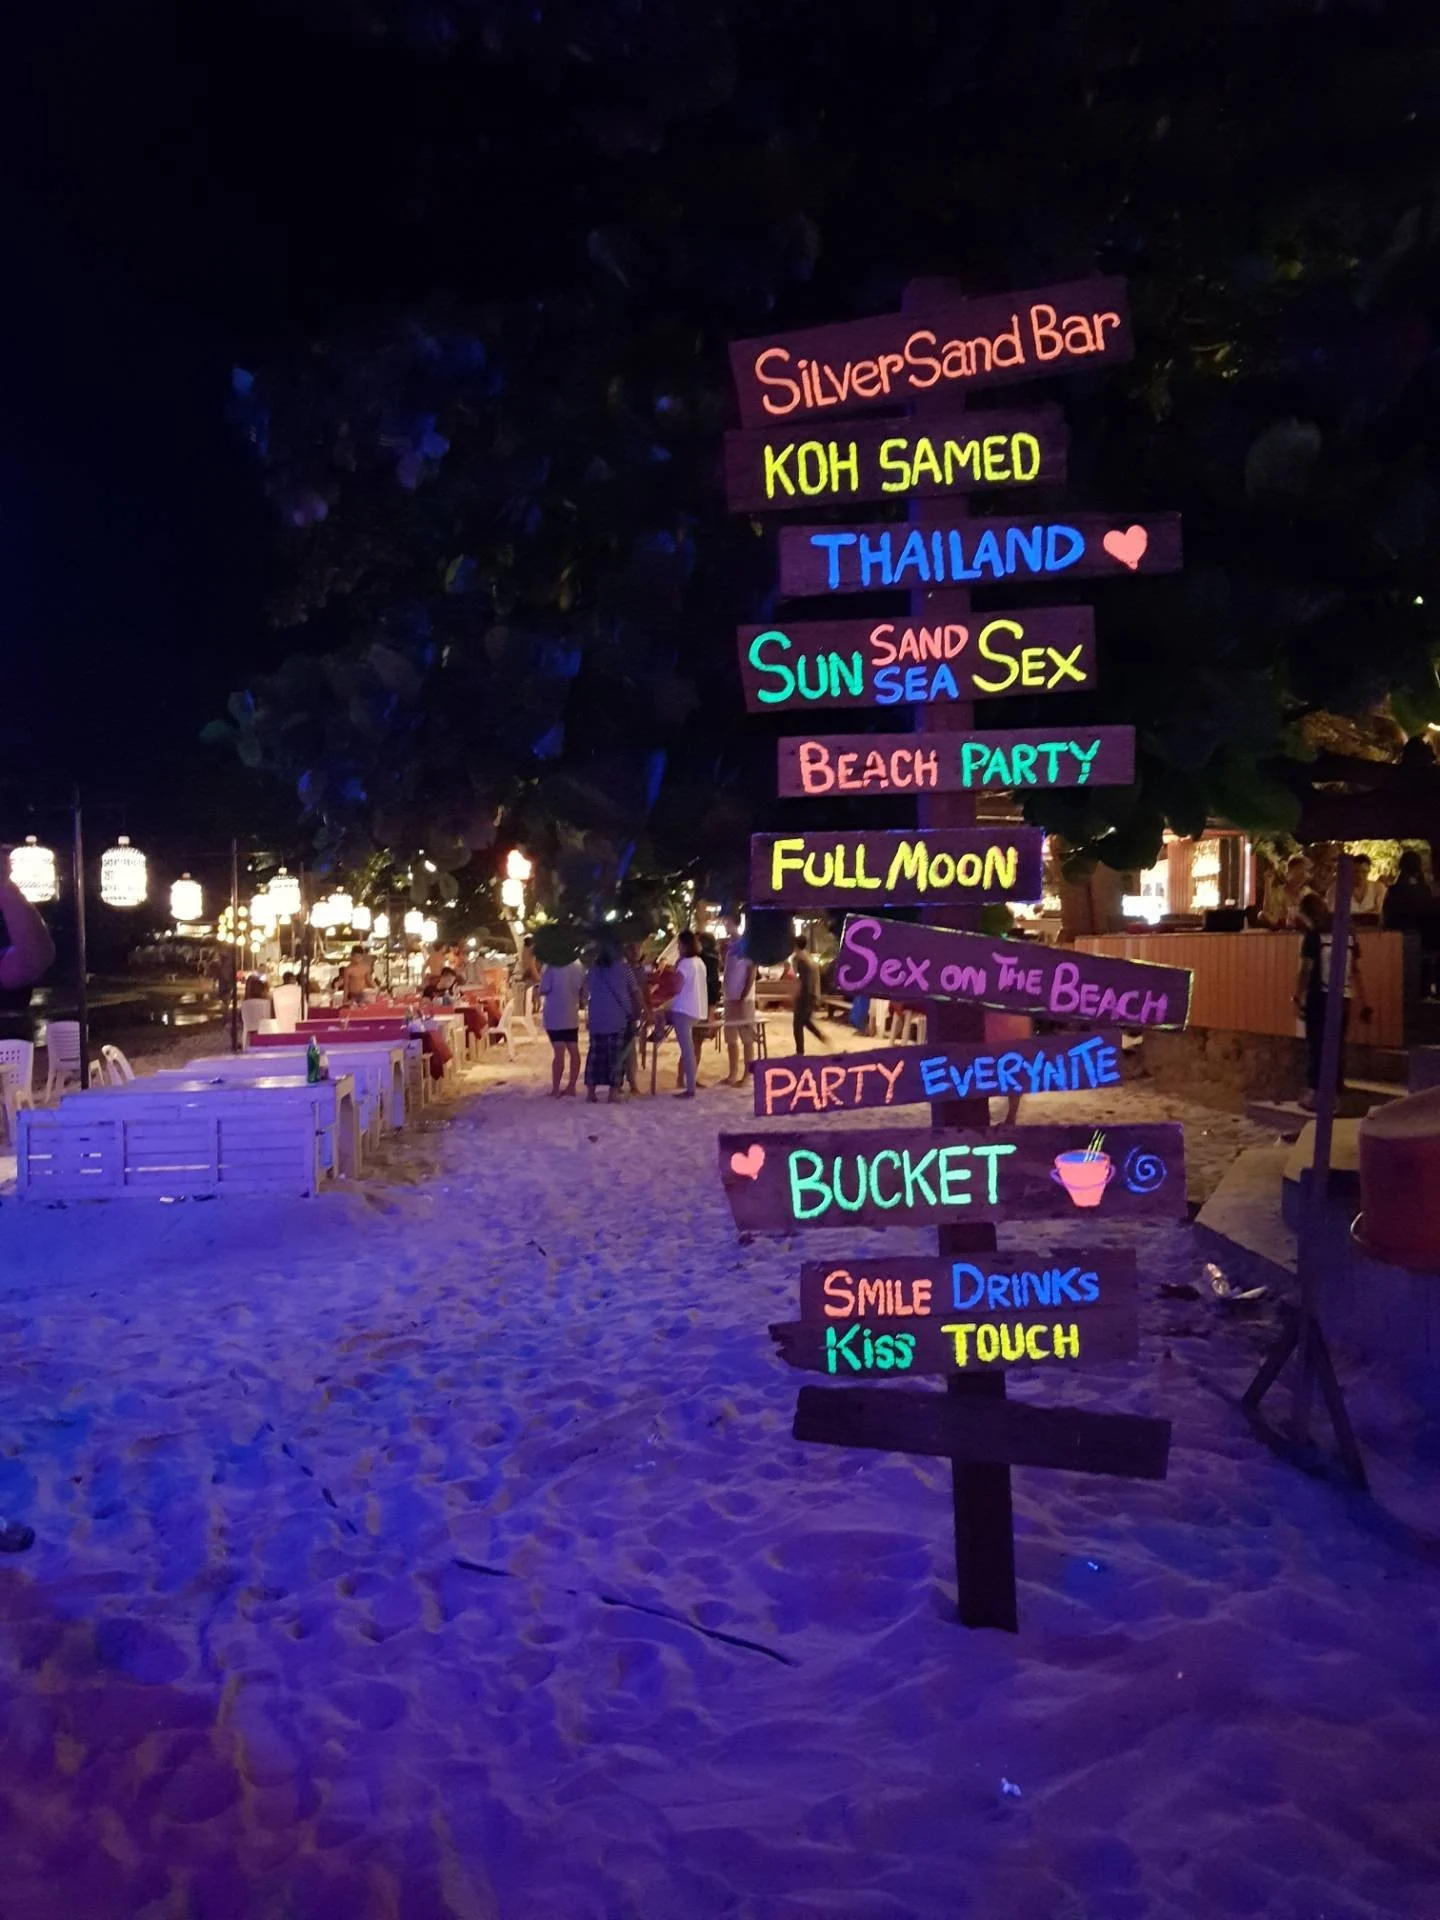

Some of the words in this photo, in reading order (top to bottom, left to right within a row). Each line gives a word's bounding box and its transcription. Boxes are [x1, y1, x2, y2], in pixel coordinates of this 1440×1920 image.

[1031, 304, 1121, 361] Bar
[763, 440, 859, 498] KOH
[879, 432, 1041, 492] SAMED
[810, 524, 1086, 589] THAILAND
[869, 624, 970, 666] SAND
[874, 664, 960, 704] SEA
[799, 741, 939, 793] BEACH
[961, 739, 1101, 787] PARTY
[771, 837, 882, 891] FULL
[885, 840, 1018, 892] MOON
[1050, 961, 1169, 1024] BEACH
[764, 1059, 905, 1115] PARTY
[788, 1144, 1017, 1220] BUCKET
[823, 1269, 933, 1318] SMILE
[940, 1323, 1080, 1368] TOUCH
